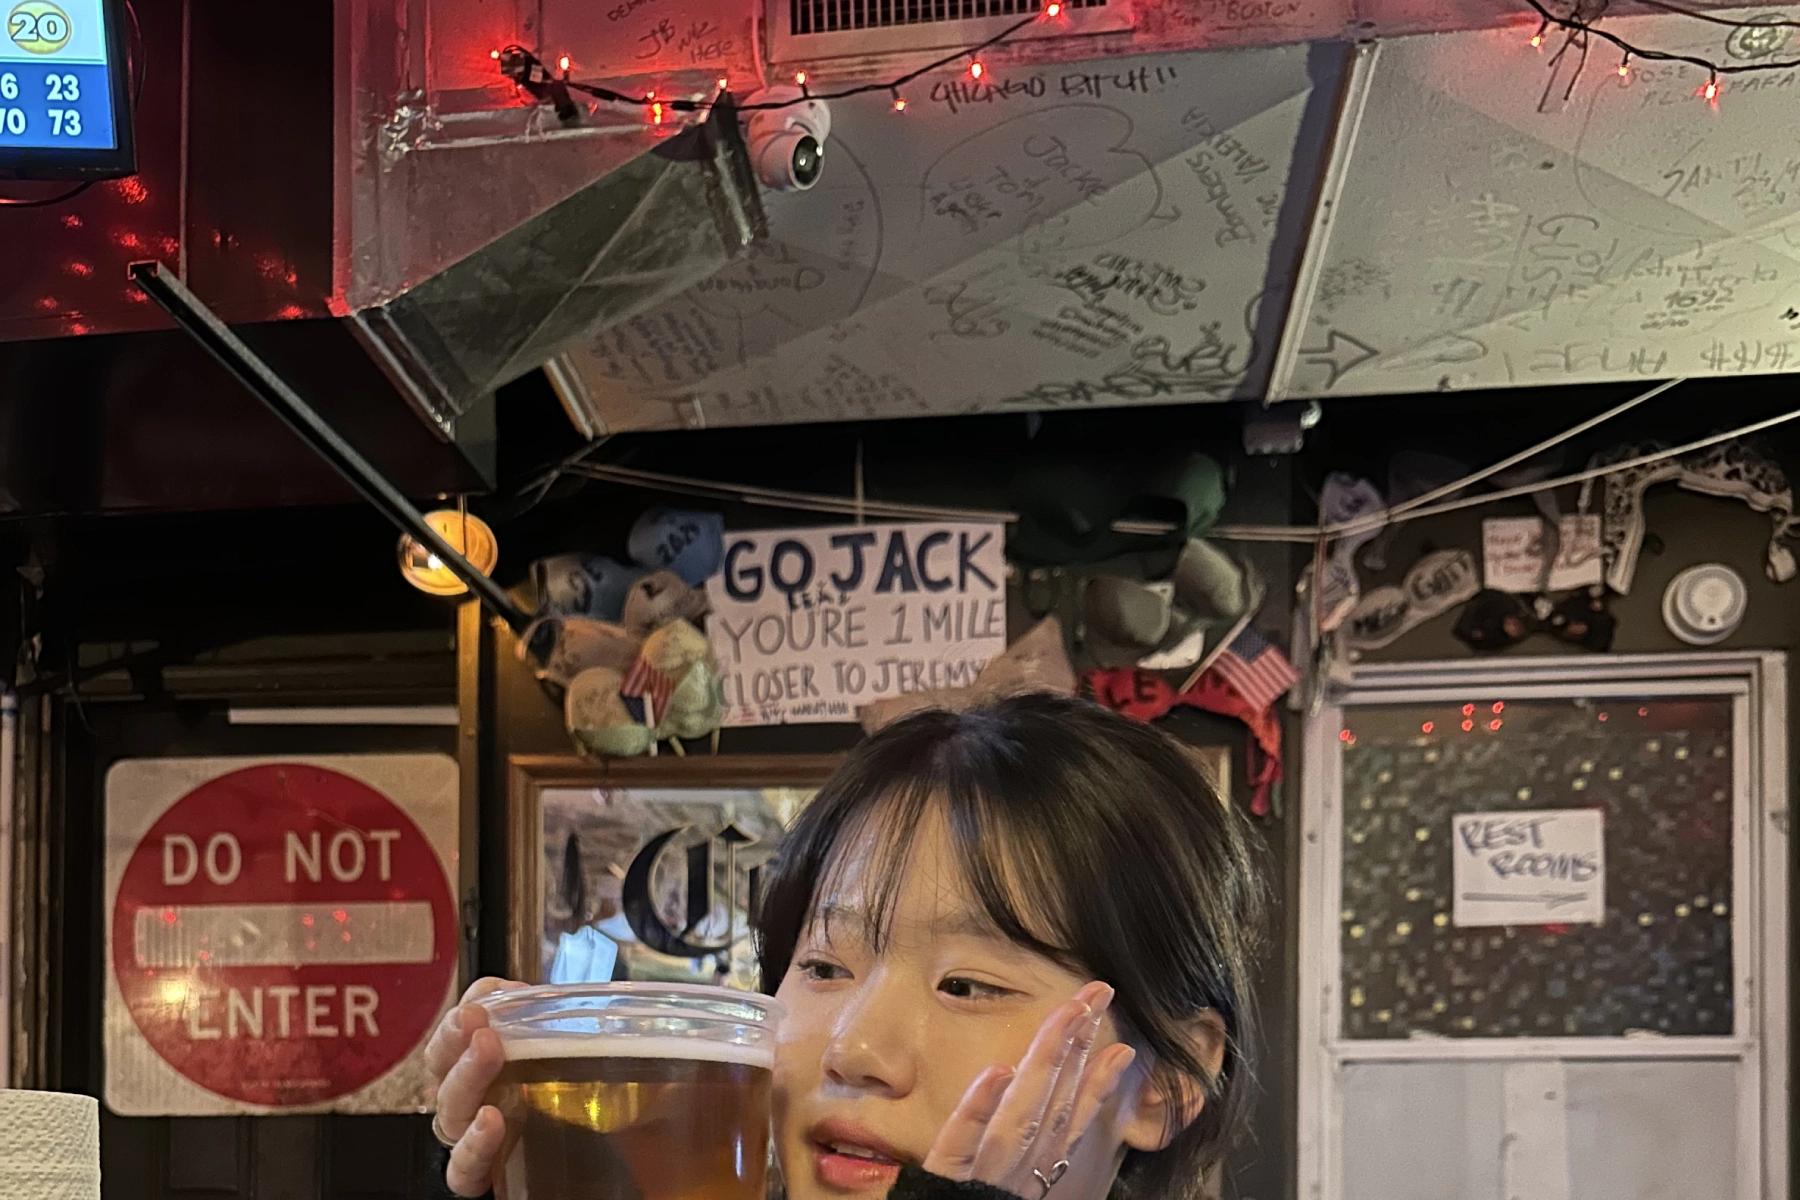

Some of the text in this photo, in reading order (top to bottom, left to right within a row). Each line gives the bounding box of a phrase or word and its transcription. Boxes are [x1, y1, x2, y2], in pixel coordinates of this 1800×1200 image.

[10, 11, 68, 43] 20
[44, 73, 81, 101] 23
[47, 108, 83, 136] 73
[724, 539, 815, 602] GO
[830, 529, 998, 594] JACK
[884, 603, 912, 645] 1
[922, 599, 1005, 643] MILE
[719, 658, 986, 706] CLOSER TO JEREMY
[1459, 816, 1559, 857] REST
[162, 831, 402, 886] DO NOT
[1488, 850, 1598, 883] ROOMS
[189, 984, 381, 1041] ENTER
